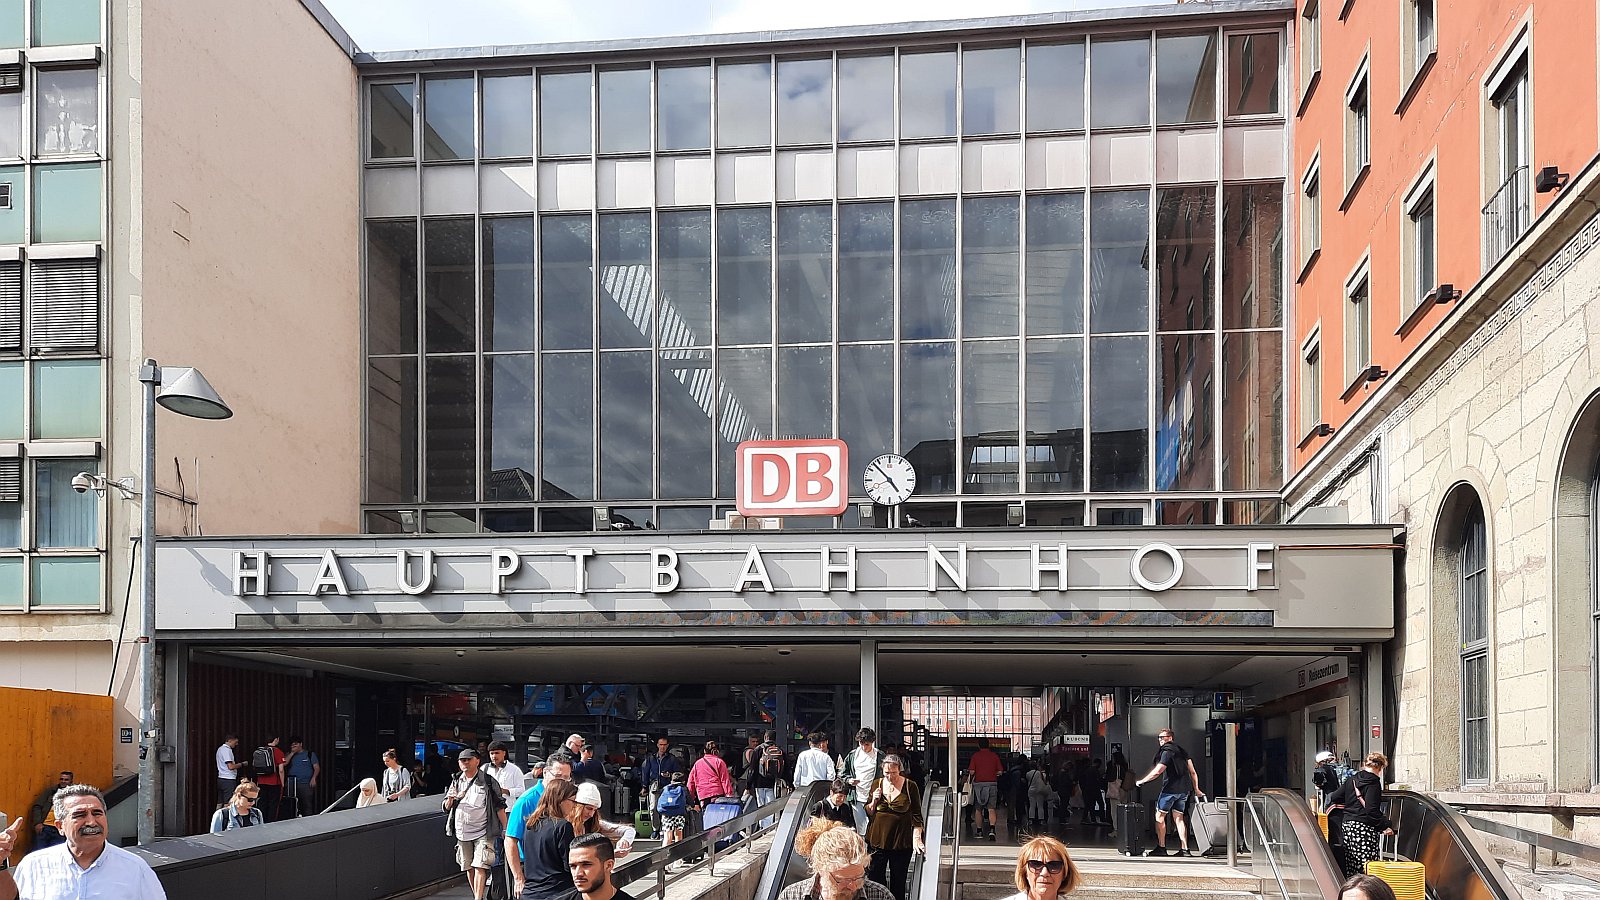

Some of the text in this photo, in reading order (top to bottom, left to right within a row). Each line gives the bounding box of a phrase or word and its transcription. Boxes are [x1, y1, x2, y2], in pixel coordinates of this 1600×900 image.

[751, 452, 834, 503] DB
[233, 542, 1274, 597] HAUPTBAHNHOF
[1308, 663, 1340, 682] Reisezentrum
